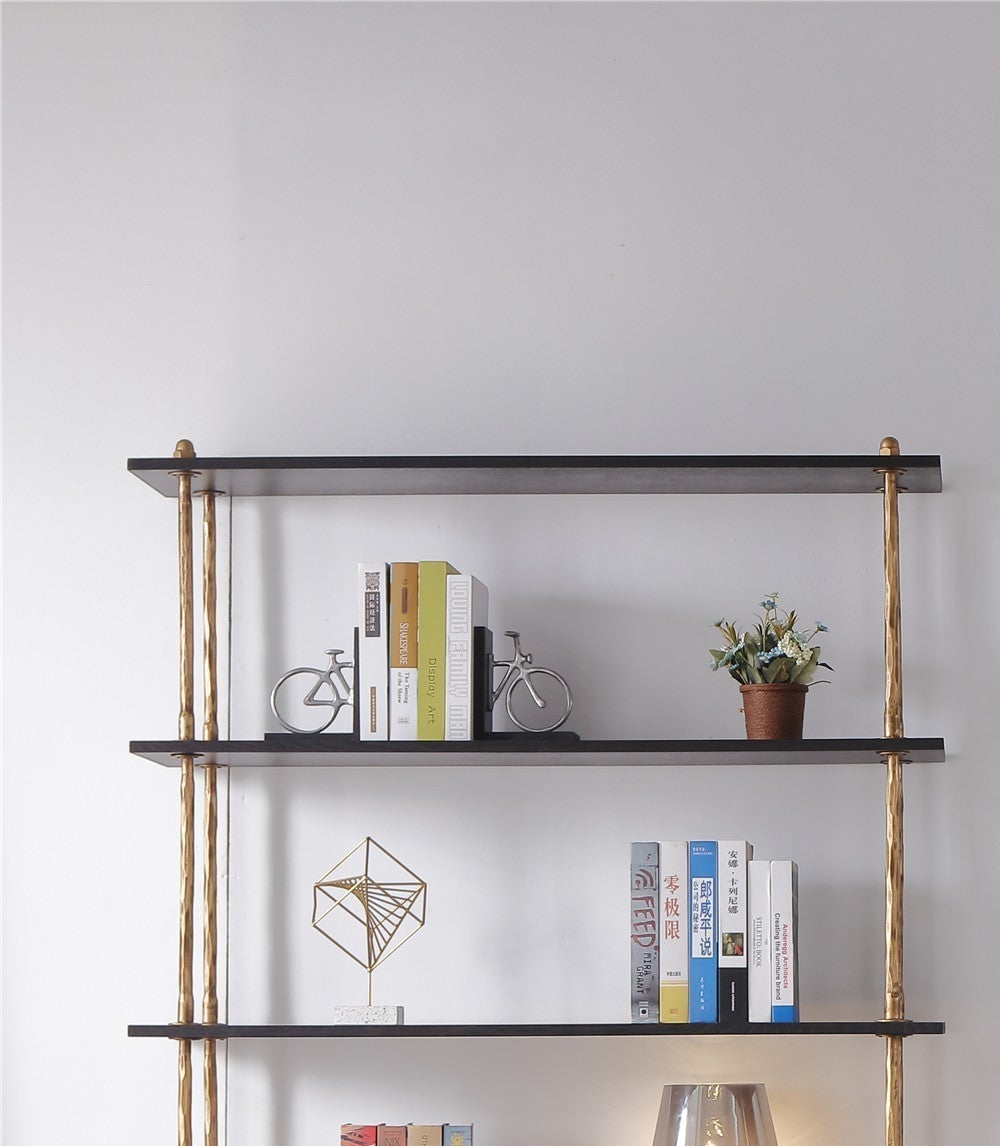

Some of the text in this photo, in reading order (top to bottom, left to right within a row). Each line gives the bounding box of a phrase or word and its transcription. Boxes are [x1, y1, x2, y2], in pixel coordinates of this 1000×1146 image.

[399, 622, 410, 666] SHAKESPEARE
[427, 657, 437, 725] Display Art
[449, 704, 468, 740] MAN
[631, 895, 657, 948] FEED
[663, 874, 680, 940] 零极限
[699, 880, 712, 956] 郎咸平说
[773, 912, 781, 940] Creating
[636, 966, 644, 994] GRANT
[643, 952, 652, 976] MIRA
